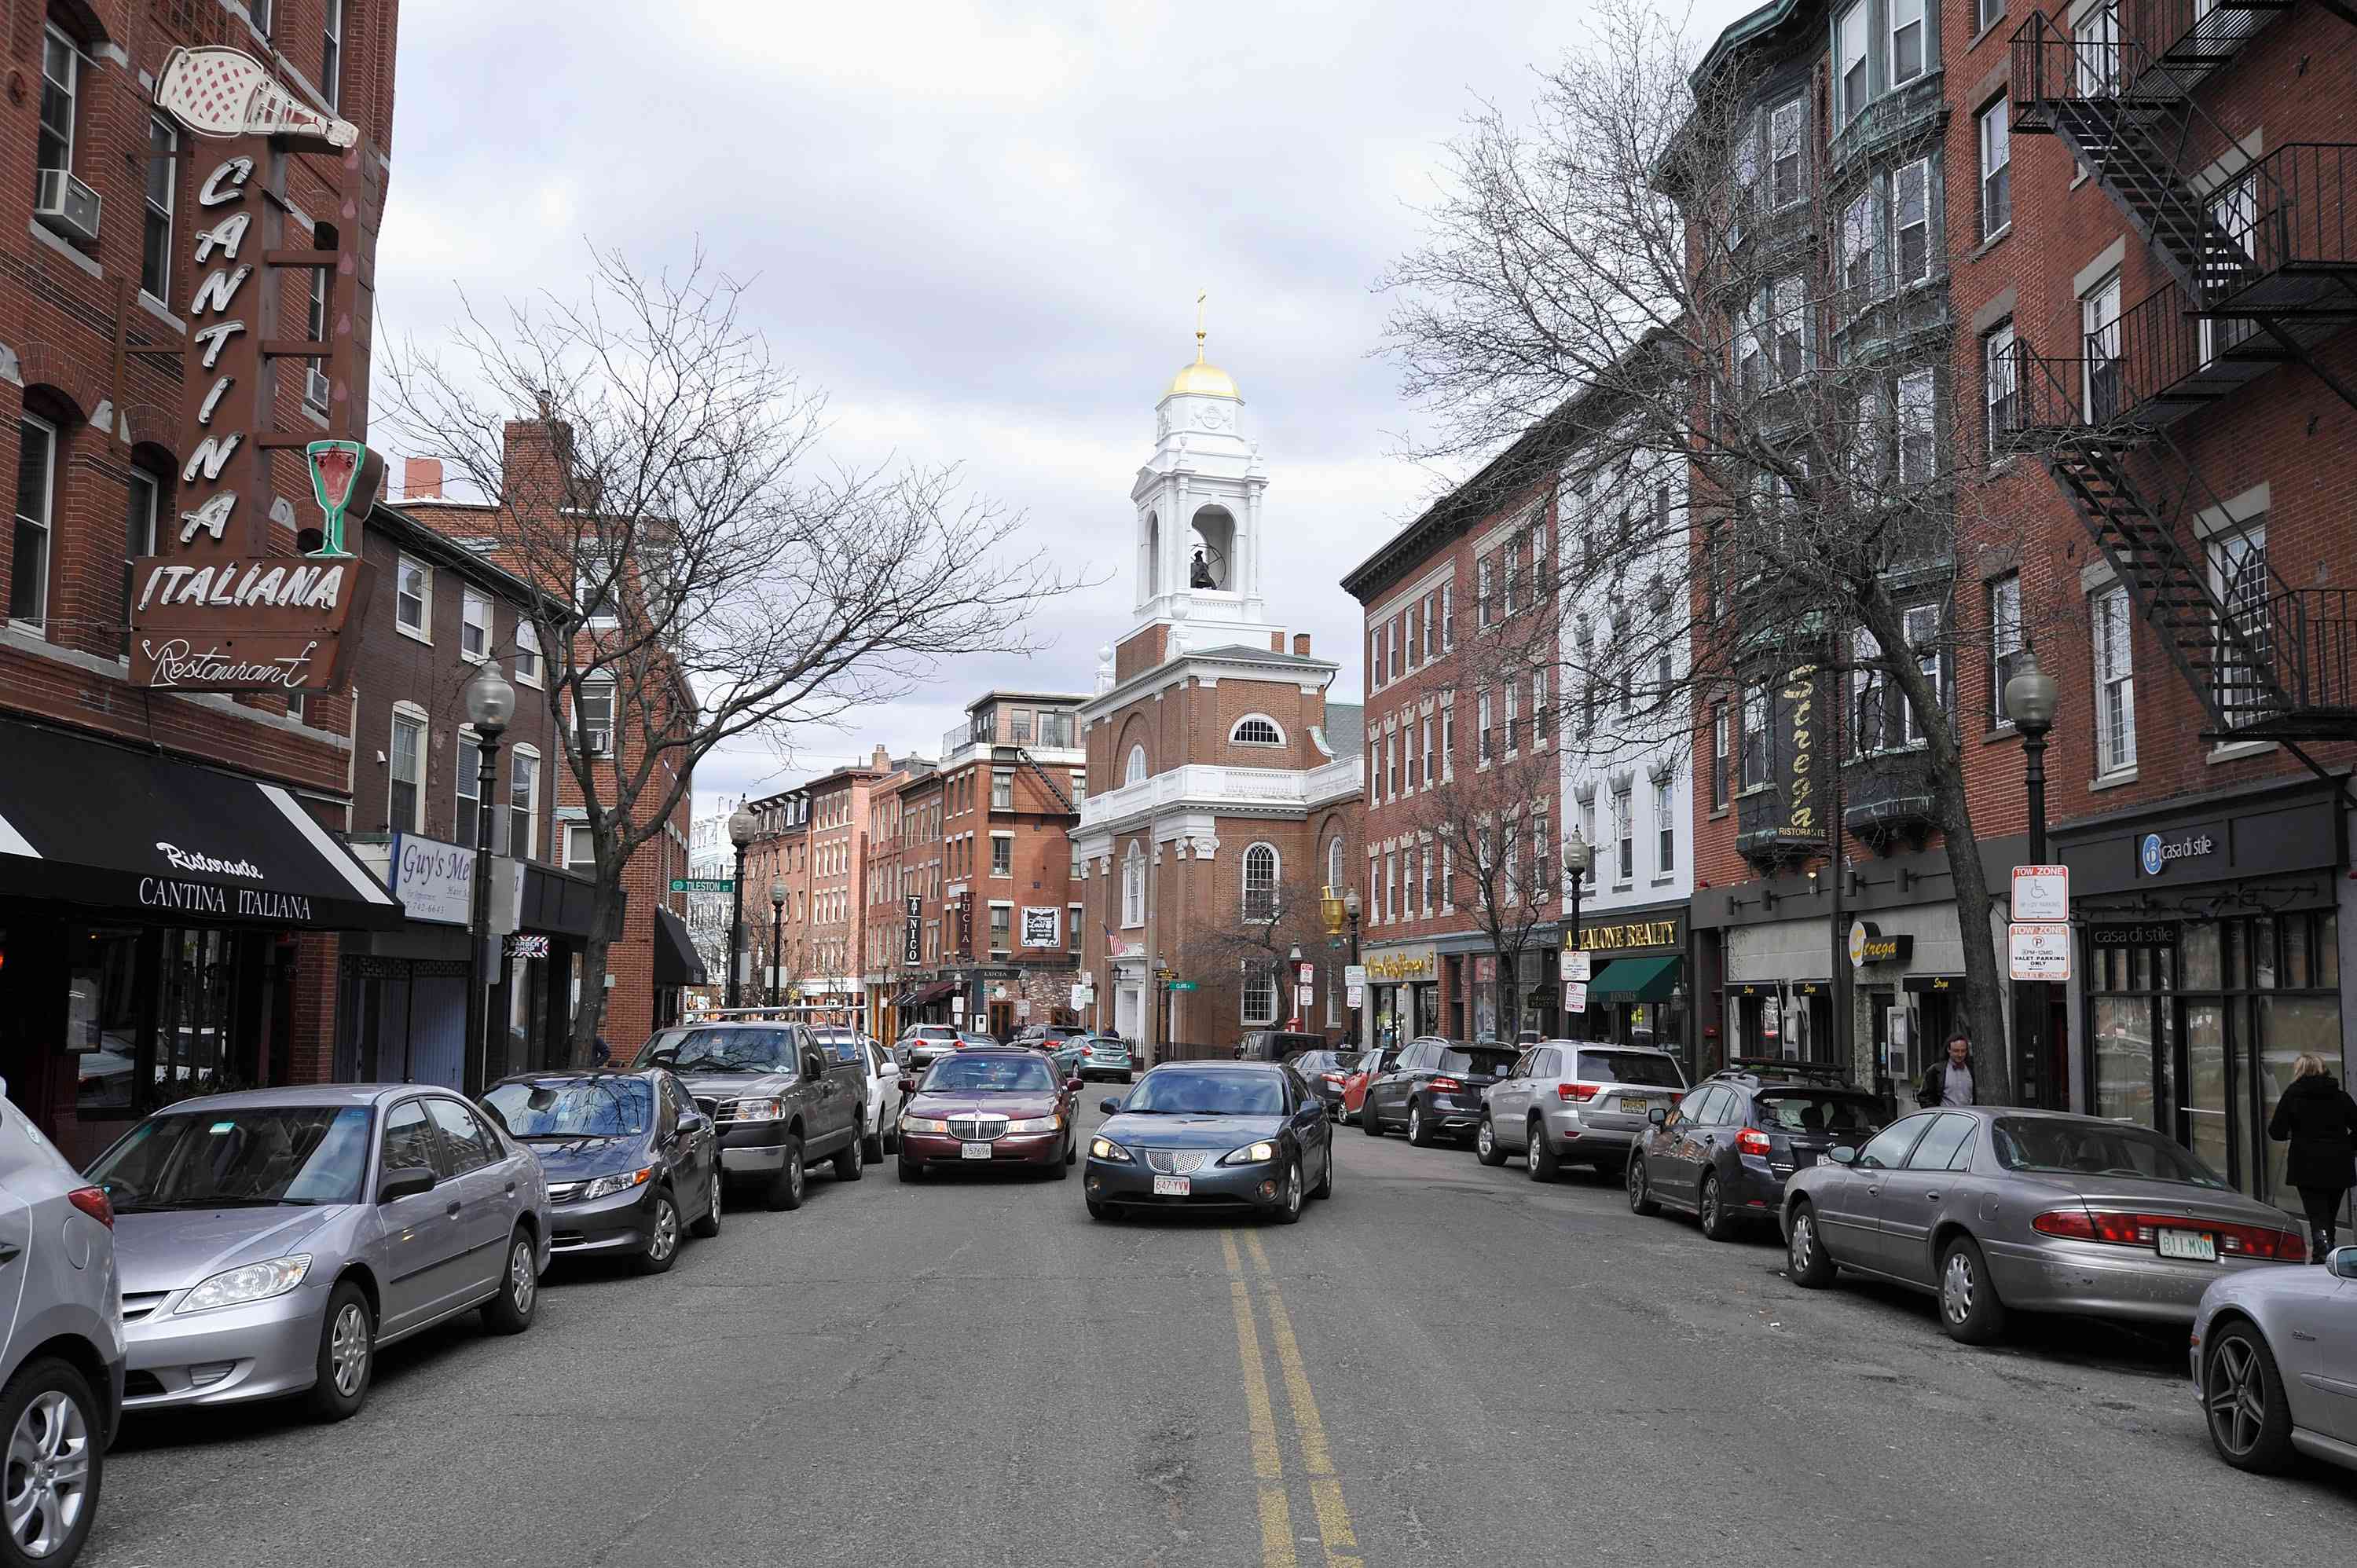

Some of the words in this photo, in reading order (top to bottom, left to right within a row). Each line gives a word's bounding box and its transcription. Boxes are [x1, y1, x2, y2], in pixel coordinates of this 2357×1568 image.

[180, 156, 254, 544] CANTINA
[138, 562, 344, 610] ITALIANA
[142, 639, 317, 687] Restaurant
[156, 842, 264, 879] Ristorante
[403, 844, 445, 885] Guy's
[2161, 844, 2183, 860] casa
[2183, 837, 2192, 857] di
[2193, 834, 2212, 855] stile
[686, 881, 720, 891] TILESTON
[2015, 867, 2034, 876] TOW
[2036, 867, 2064, 876] ZONE
[139, 877, 226, 912] CANTINA
[238, 889, 311, 920] ITALIANA
[962, 892, 971, 943] LUCIA
[2039, 926, 2066, 935] ZONE
[2095, 929, 2127, 943] casa
[2129, 926, 2143, 943] di
[2145, 925, 2175, 942] stile
[1565, 926, 1624, 951] AZALONE
